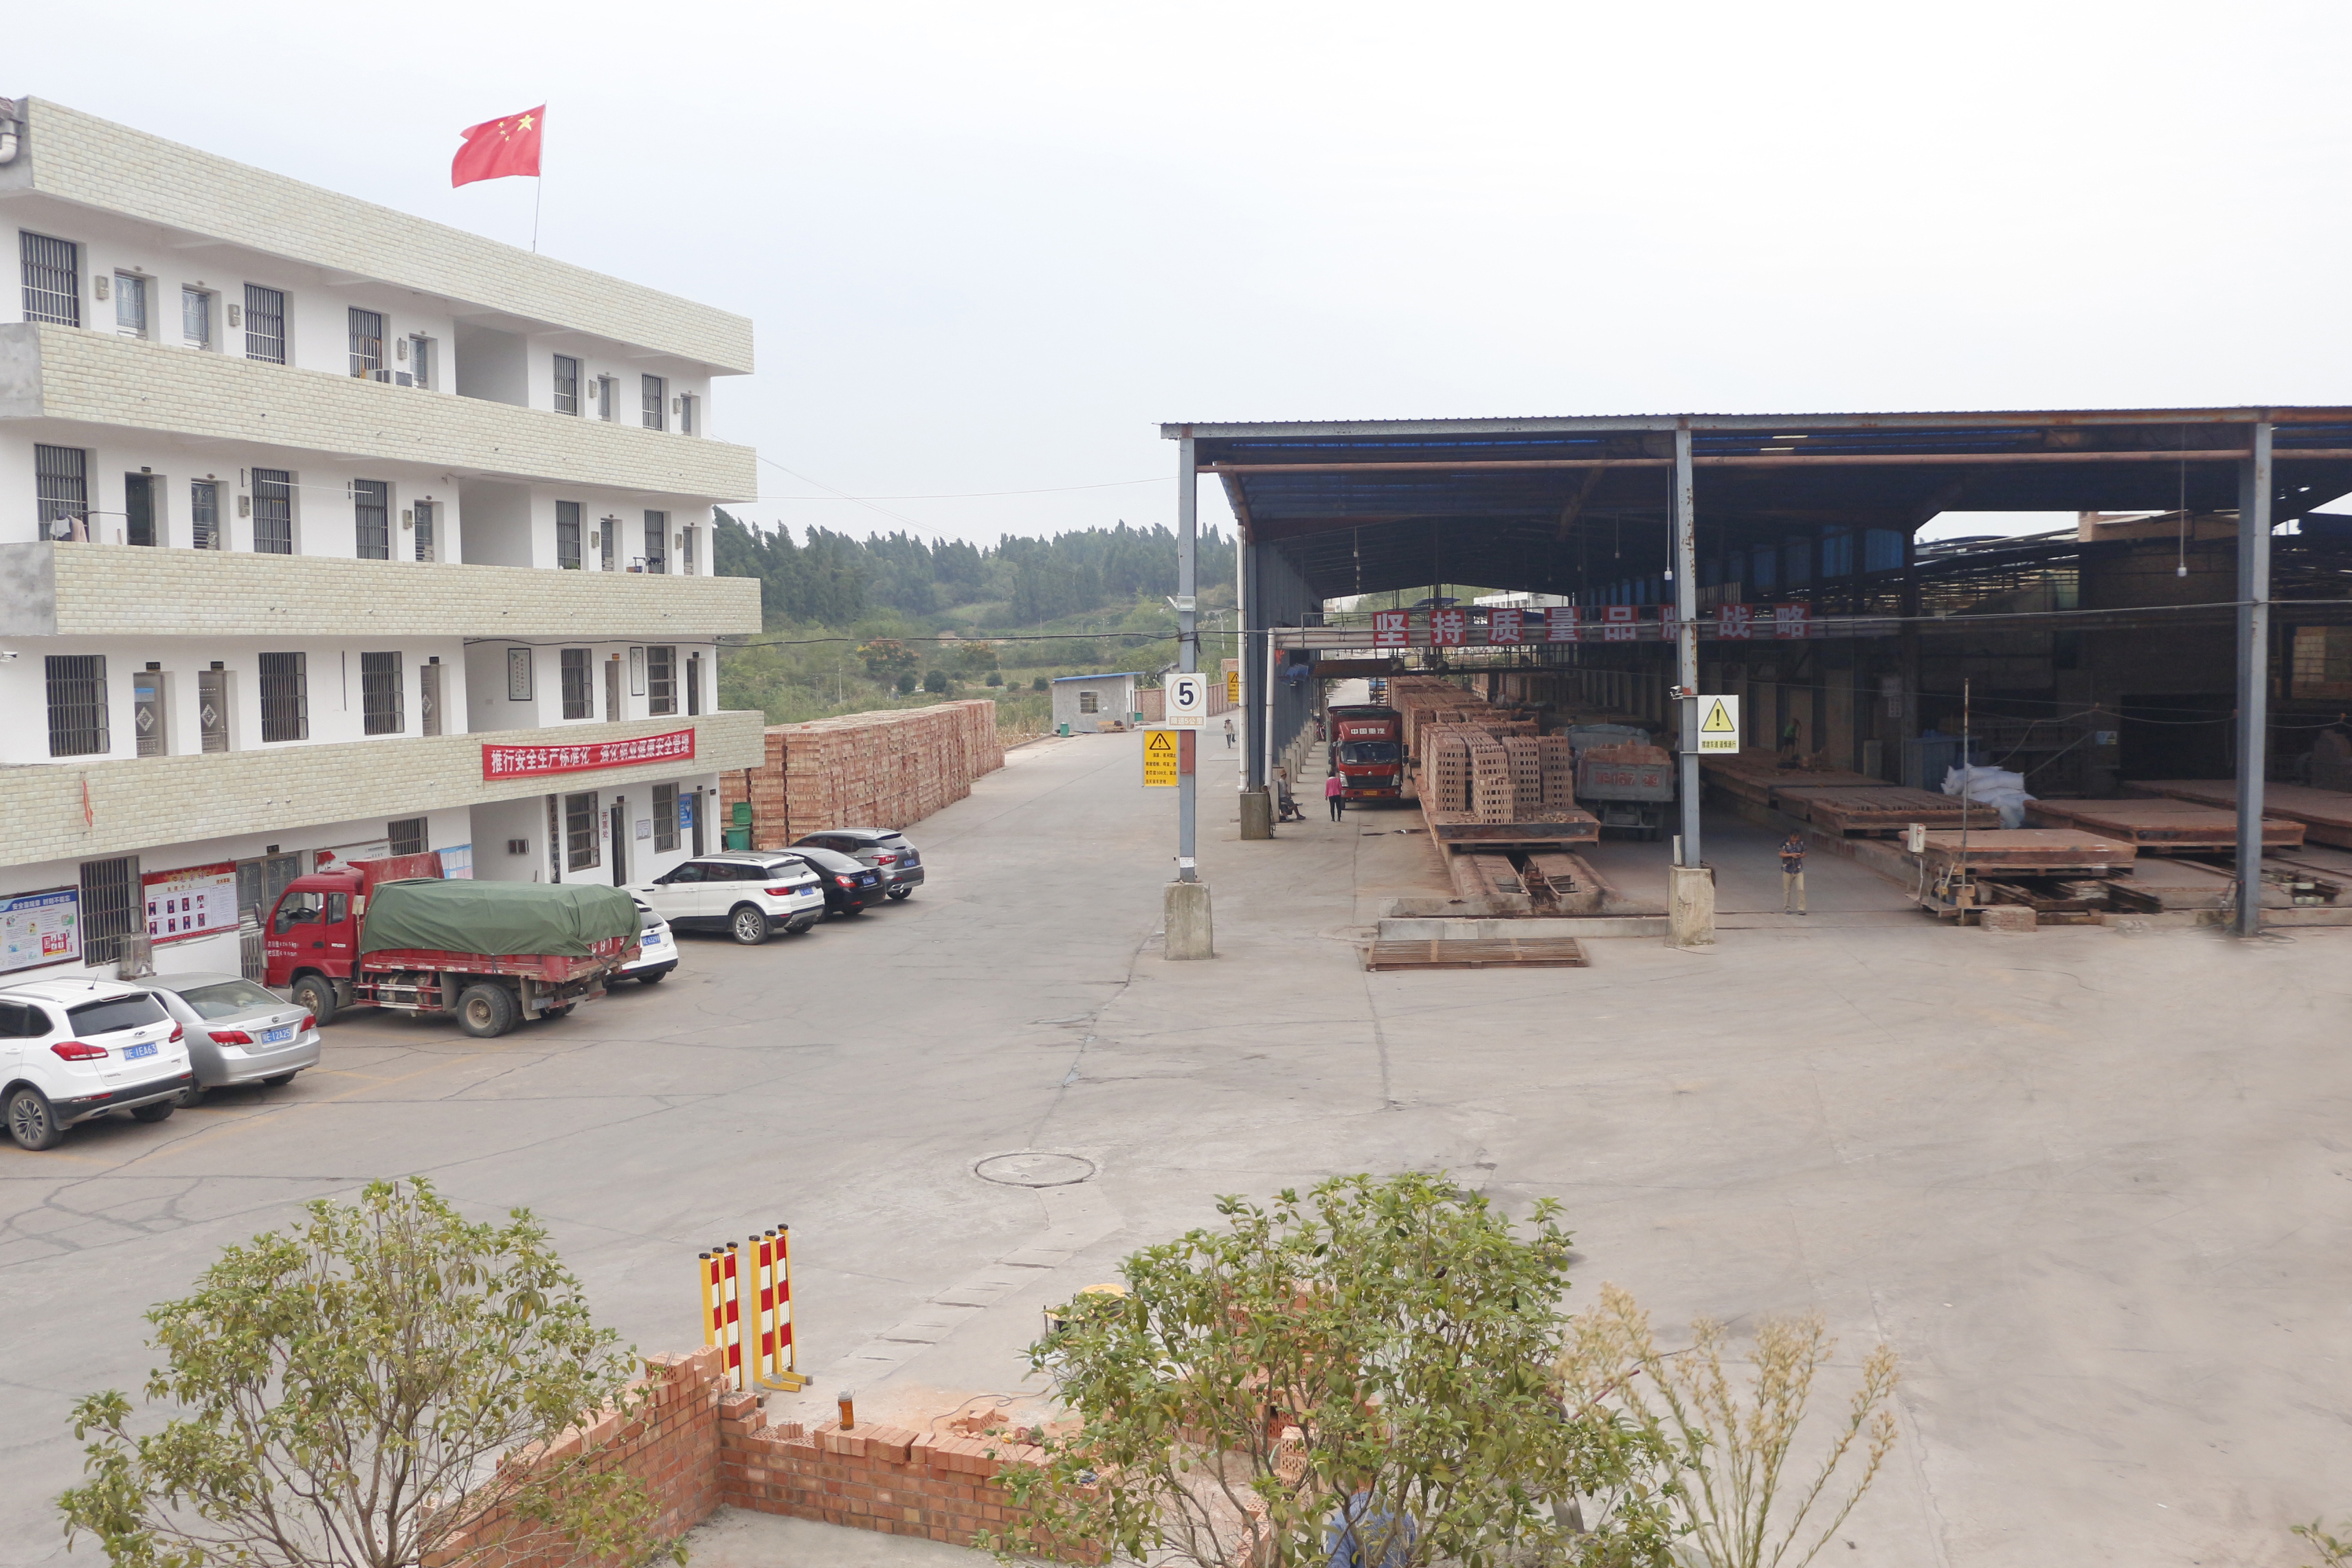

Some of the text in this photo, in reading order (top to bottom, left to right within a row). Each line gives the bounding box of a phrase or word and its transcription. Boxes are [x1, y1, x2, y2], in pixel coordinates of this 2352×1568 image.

[1179, 682, 1194, 706] 5
[1170, 717, 1203, 725] 限速5公里
[491, 735, 689, 773] 推行安全生产标准化 强化职业健康安全管理
[43, 895, 70, 905] 时刻不能忘
